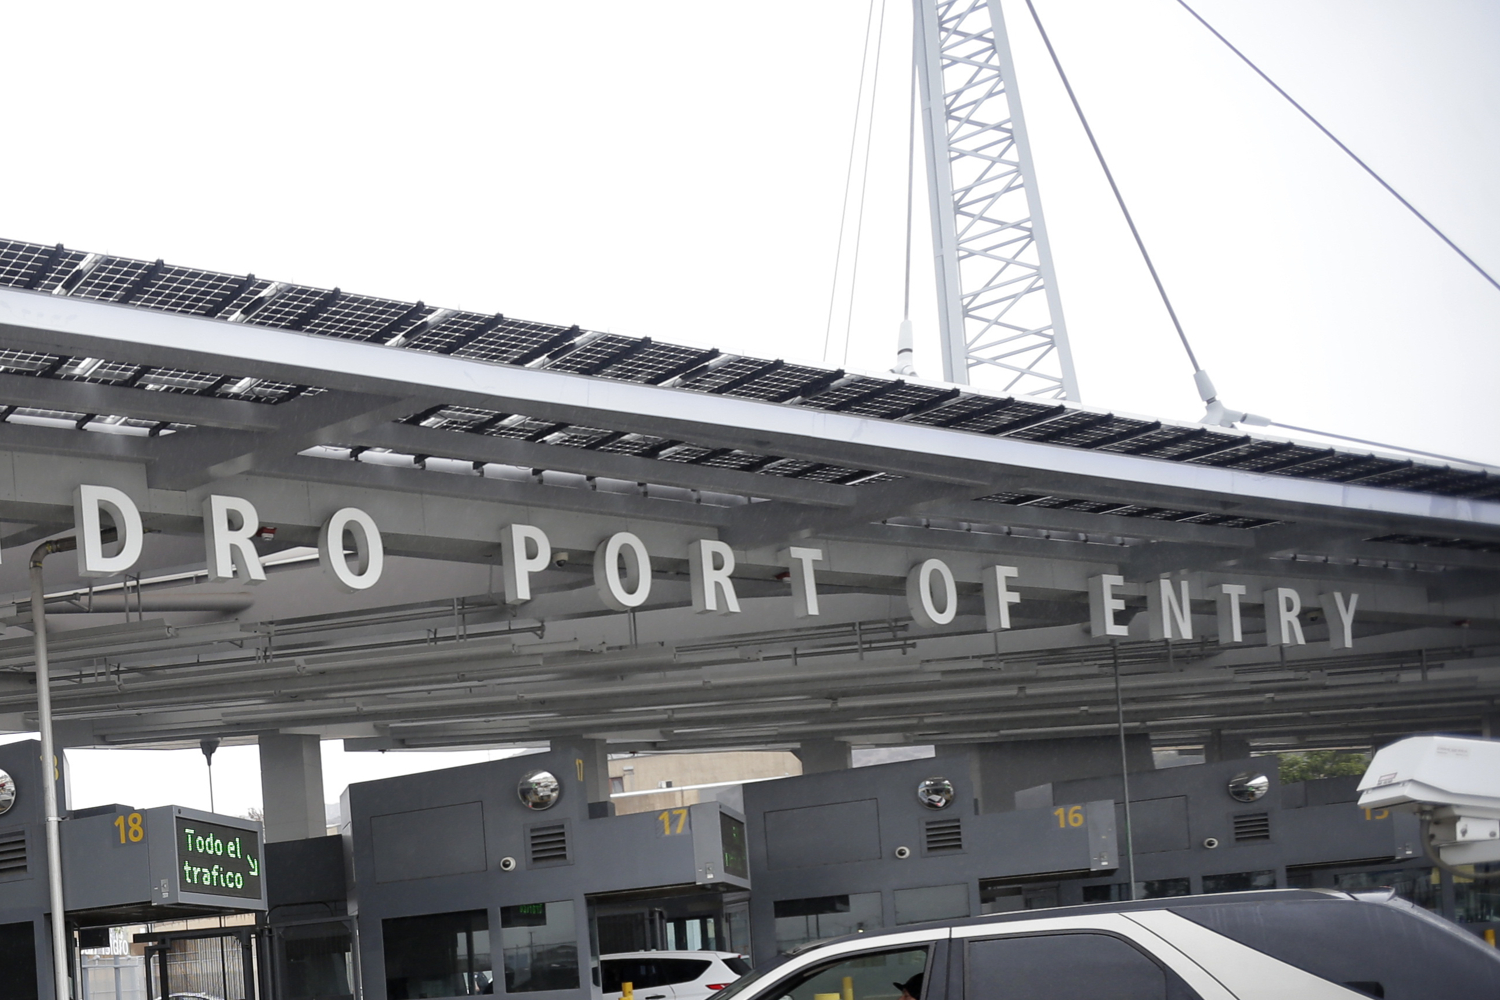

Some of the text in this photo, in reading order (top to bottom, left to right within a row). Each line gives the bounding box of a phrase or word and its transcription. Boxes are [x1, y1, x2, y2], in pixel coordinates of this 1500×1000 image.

[506, 524, 823, 617] PORT
[912, 558, 1021, 631] OF
[1092, 574, 1359, 648] ENTRY
[114, 812, 144, 844] 18
[658, 808, 688, 835] 17
[1053, 805, 1084, 828] 16
[184, 828, 242, 859] Todo el
[183, 860, 244, 890] trafico
